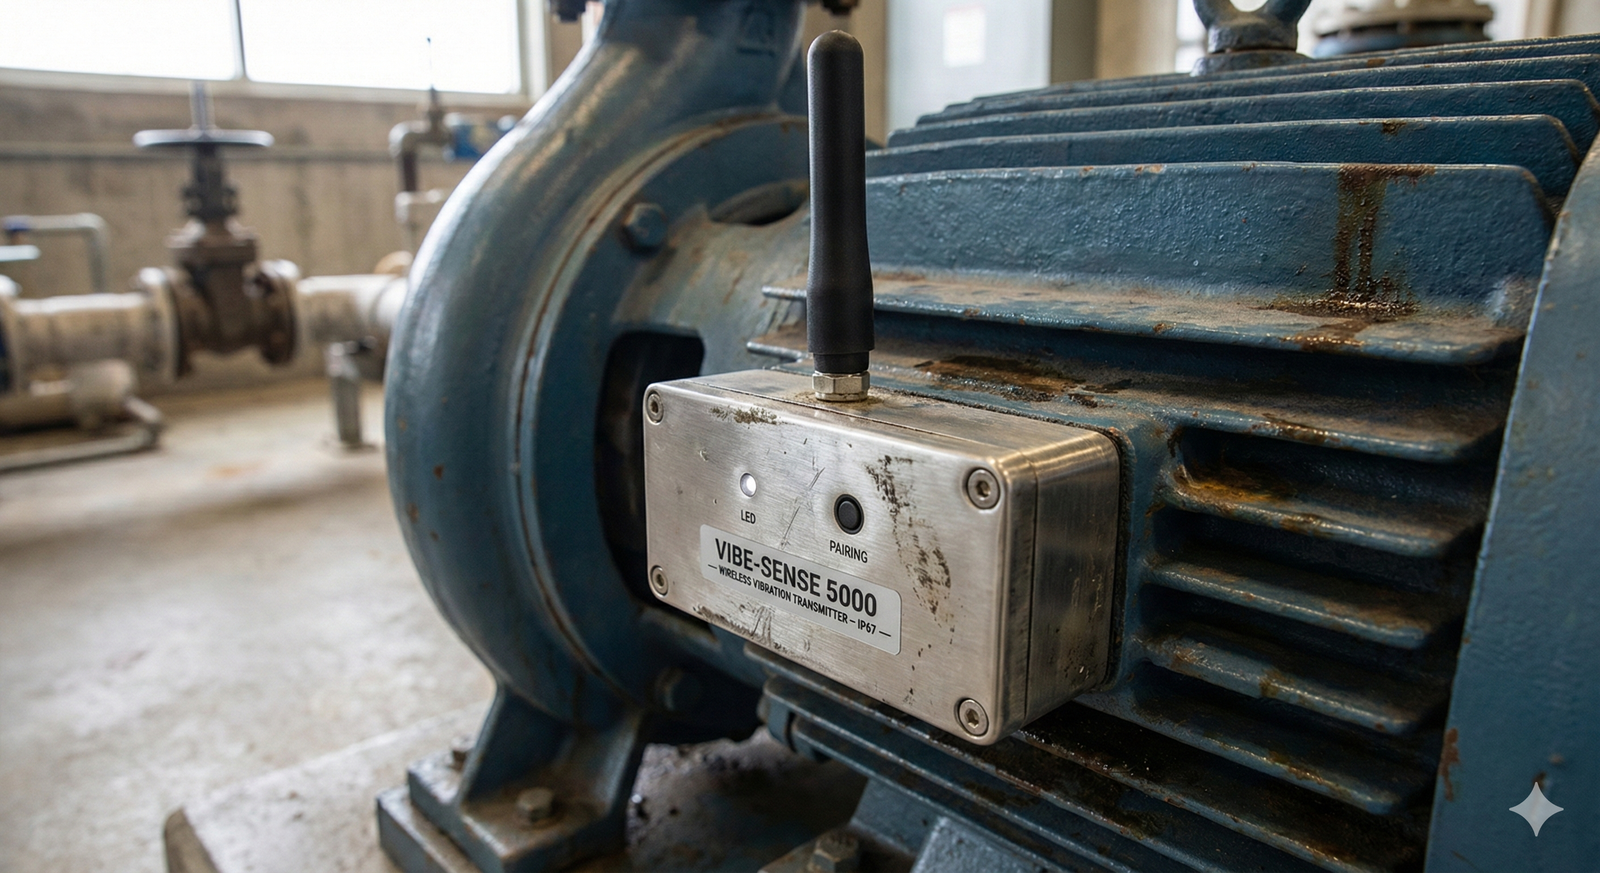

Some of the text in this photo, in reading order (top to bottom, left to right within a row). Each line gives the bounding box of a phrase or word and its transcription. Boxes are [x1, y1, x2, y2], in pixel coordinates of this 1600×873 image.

[740, 509, 756, 524] LED
[829, 539, 868, 563] PAIRING
[715, 538, 877, 617] VIBE-SENSE 5000
[718, 564, 752, 586] WIRELESS
[753, 578, 791, 602] VIBRATION
[792, 593, 848, 624] TRANSMITTER
[858, 618, 876, 635] IP67
